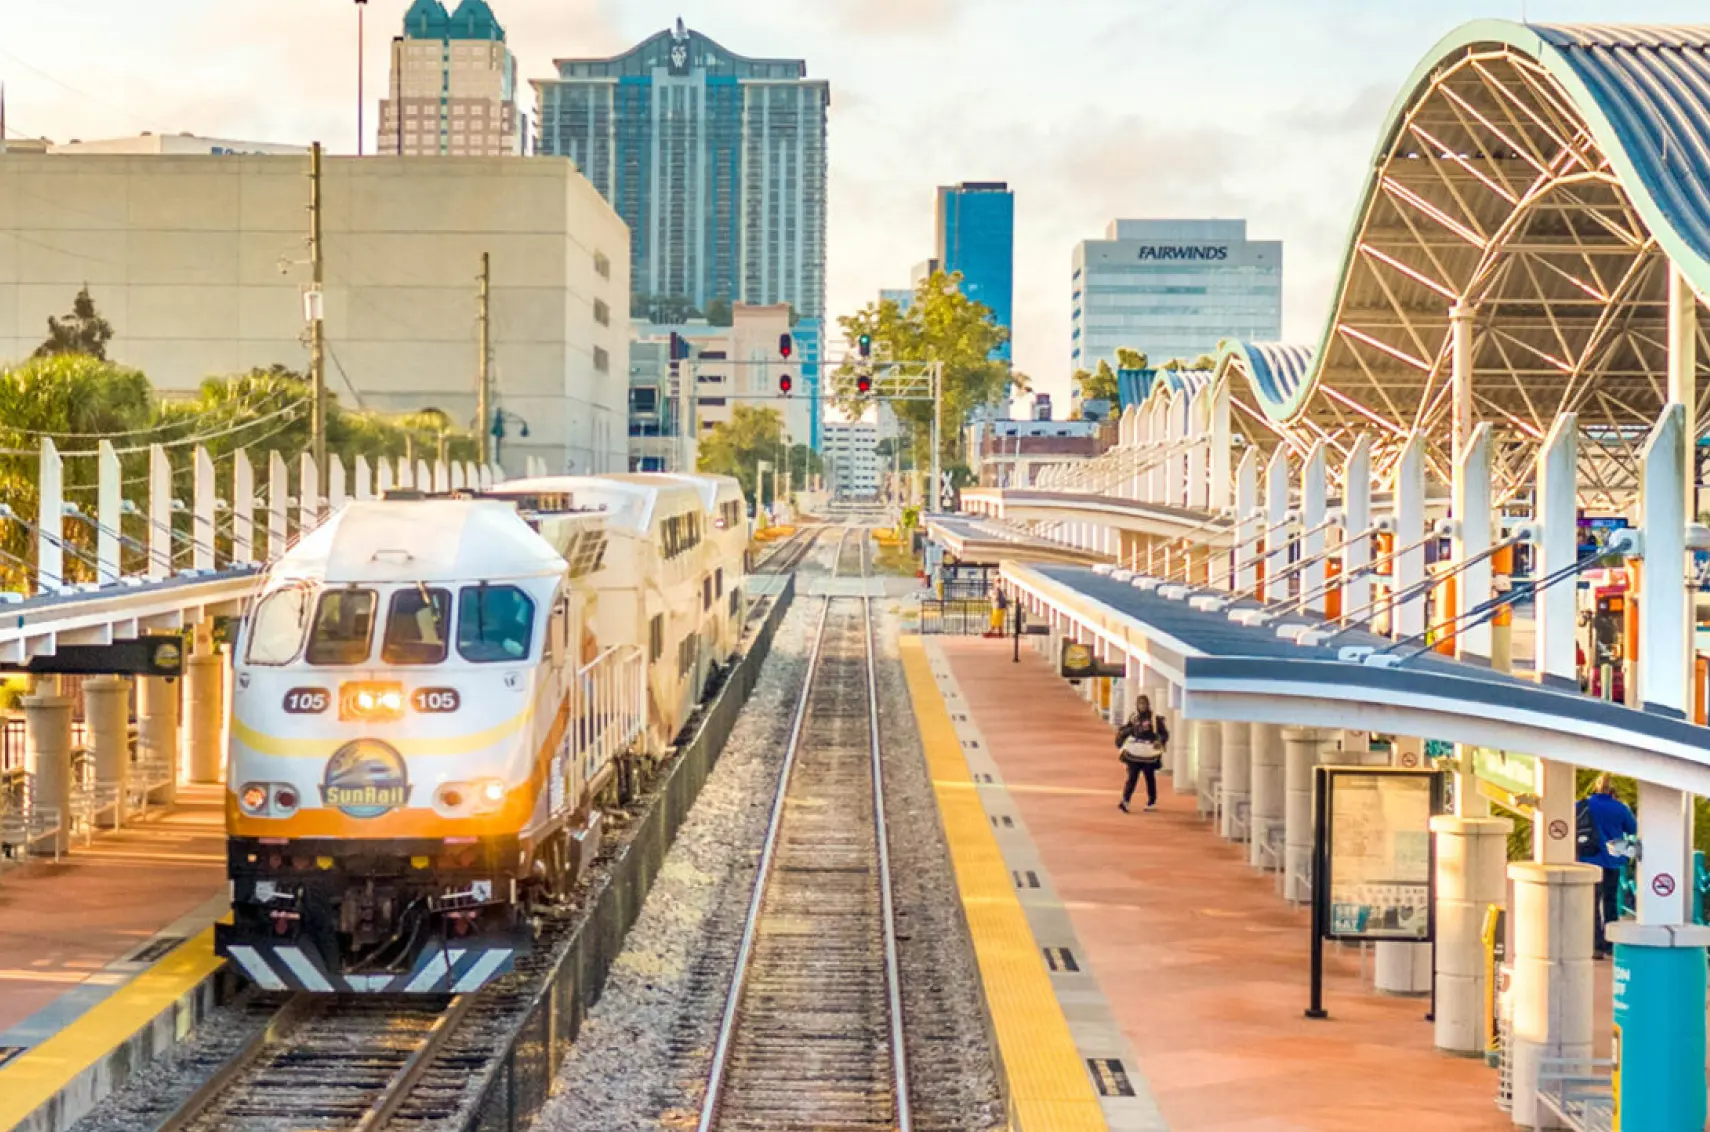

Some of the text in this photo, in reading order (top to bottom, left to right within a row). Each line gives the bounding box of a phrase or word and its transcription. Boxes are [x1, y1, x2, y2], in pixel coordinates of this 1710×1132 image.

[1138, 245, 1228, 260] FAIRWINDS
[289, 692, 326, 709] 105
[417, 691, 454, 708] 105
[327, 786, 405, 805] SunRail
